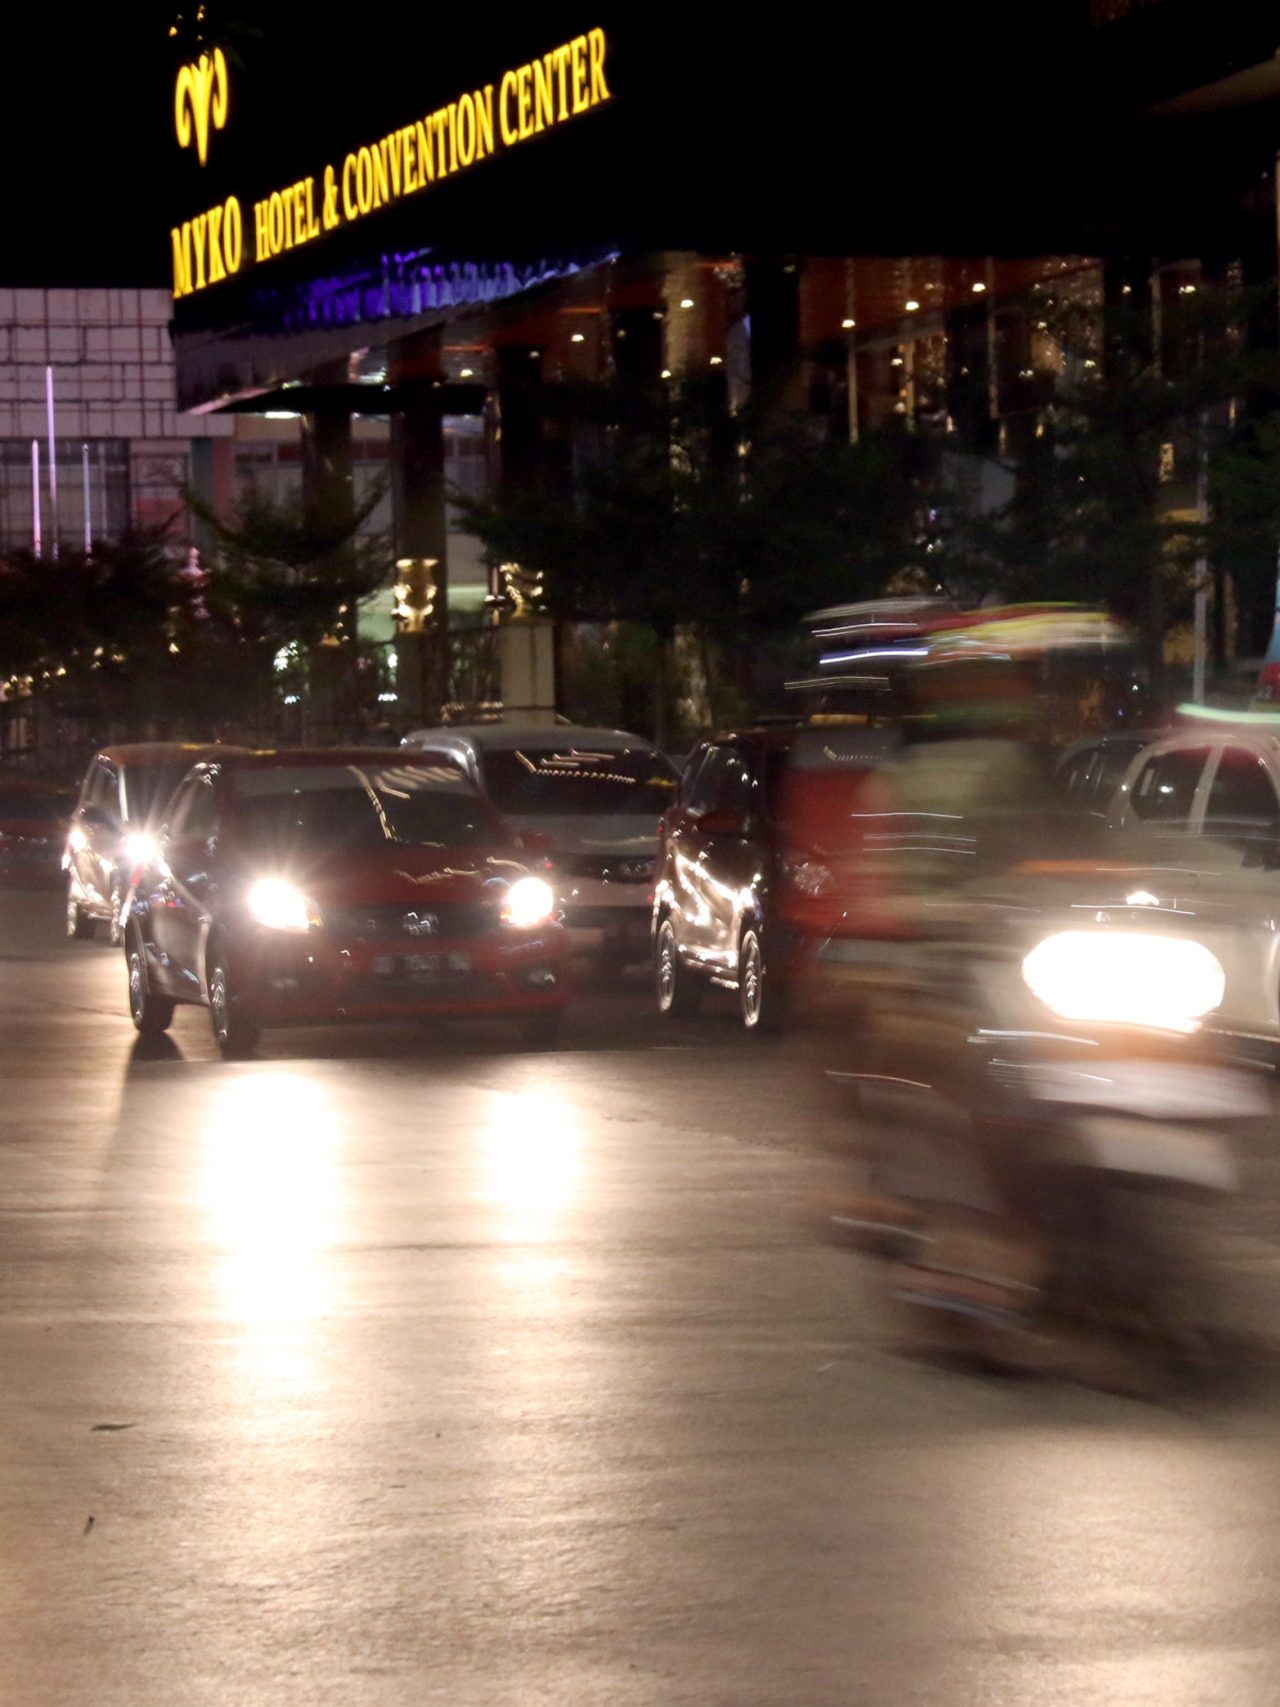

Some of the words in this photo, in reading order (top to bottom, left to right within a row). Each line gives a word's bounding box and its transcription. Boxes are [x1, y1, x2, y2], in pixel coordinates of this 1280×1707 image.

[171, 195, 243, 299] MYKO
[253, 176, 320, 263] HOTEL
[322, 164, 340, 231] &
[342, 84, 494, 220] CONVENTION
[499, 27, 610, 146] CENTER
